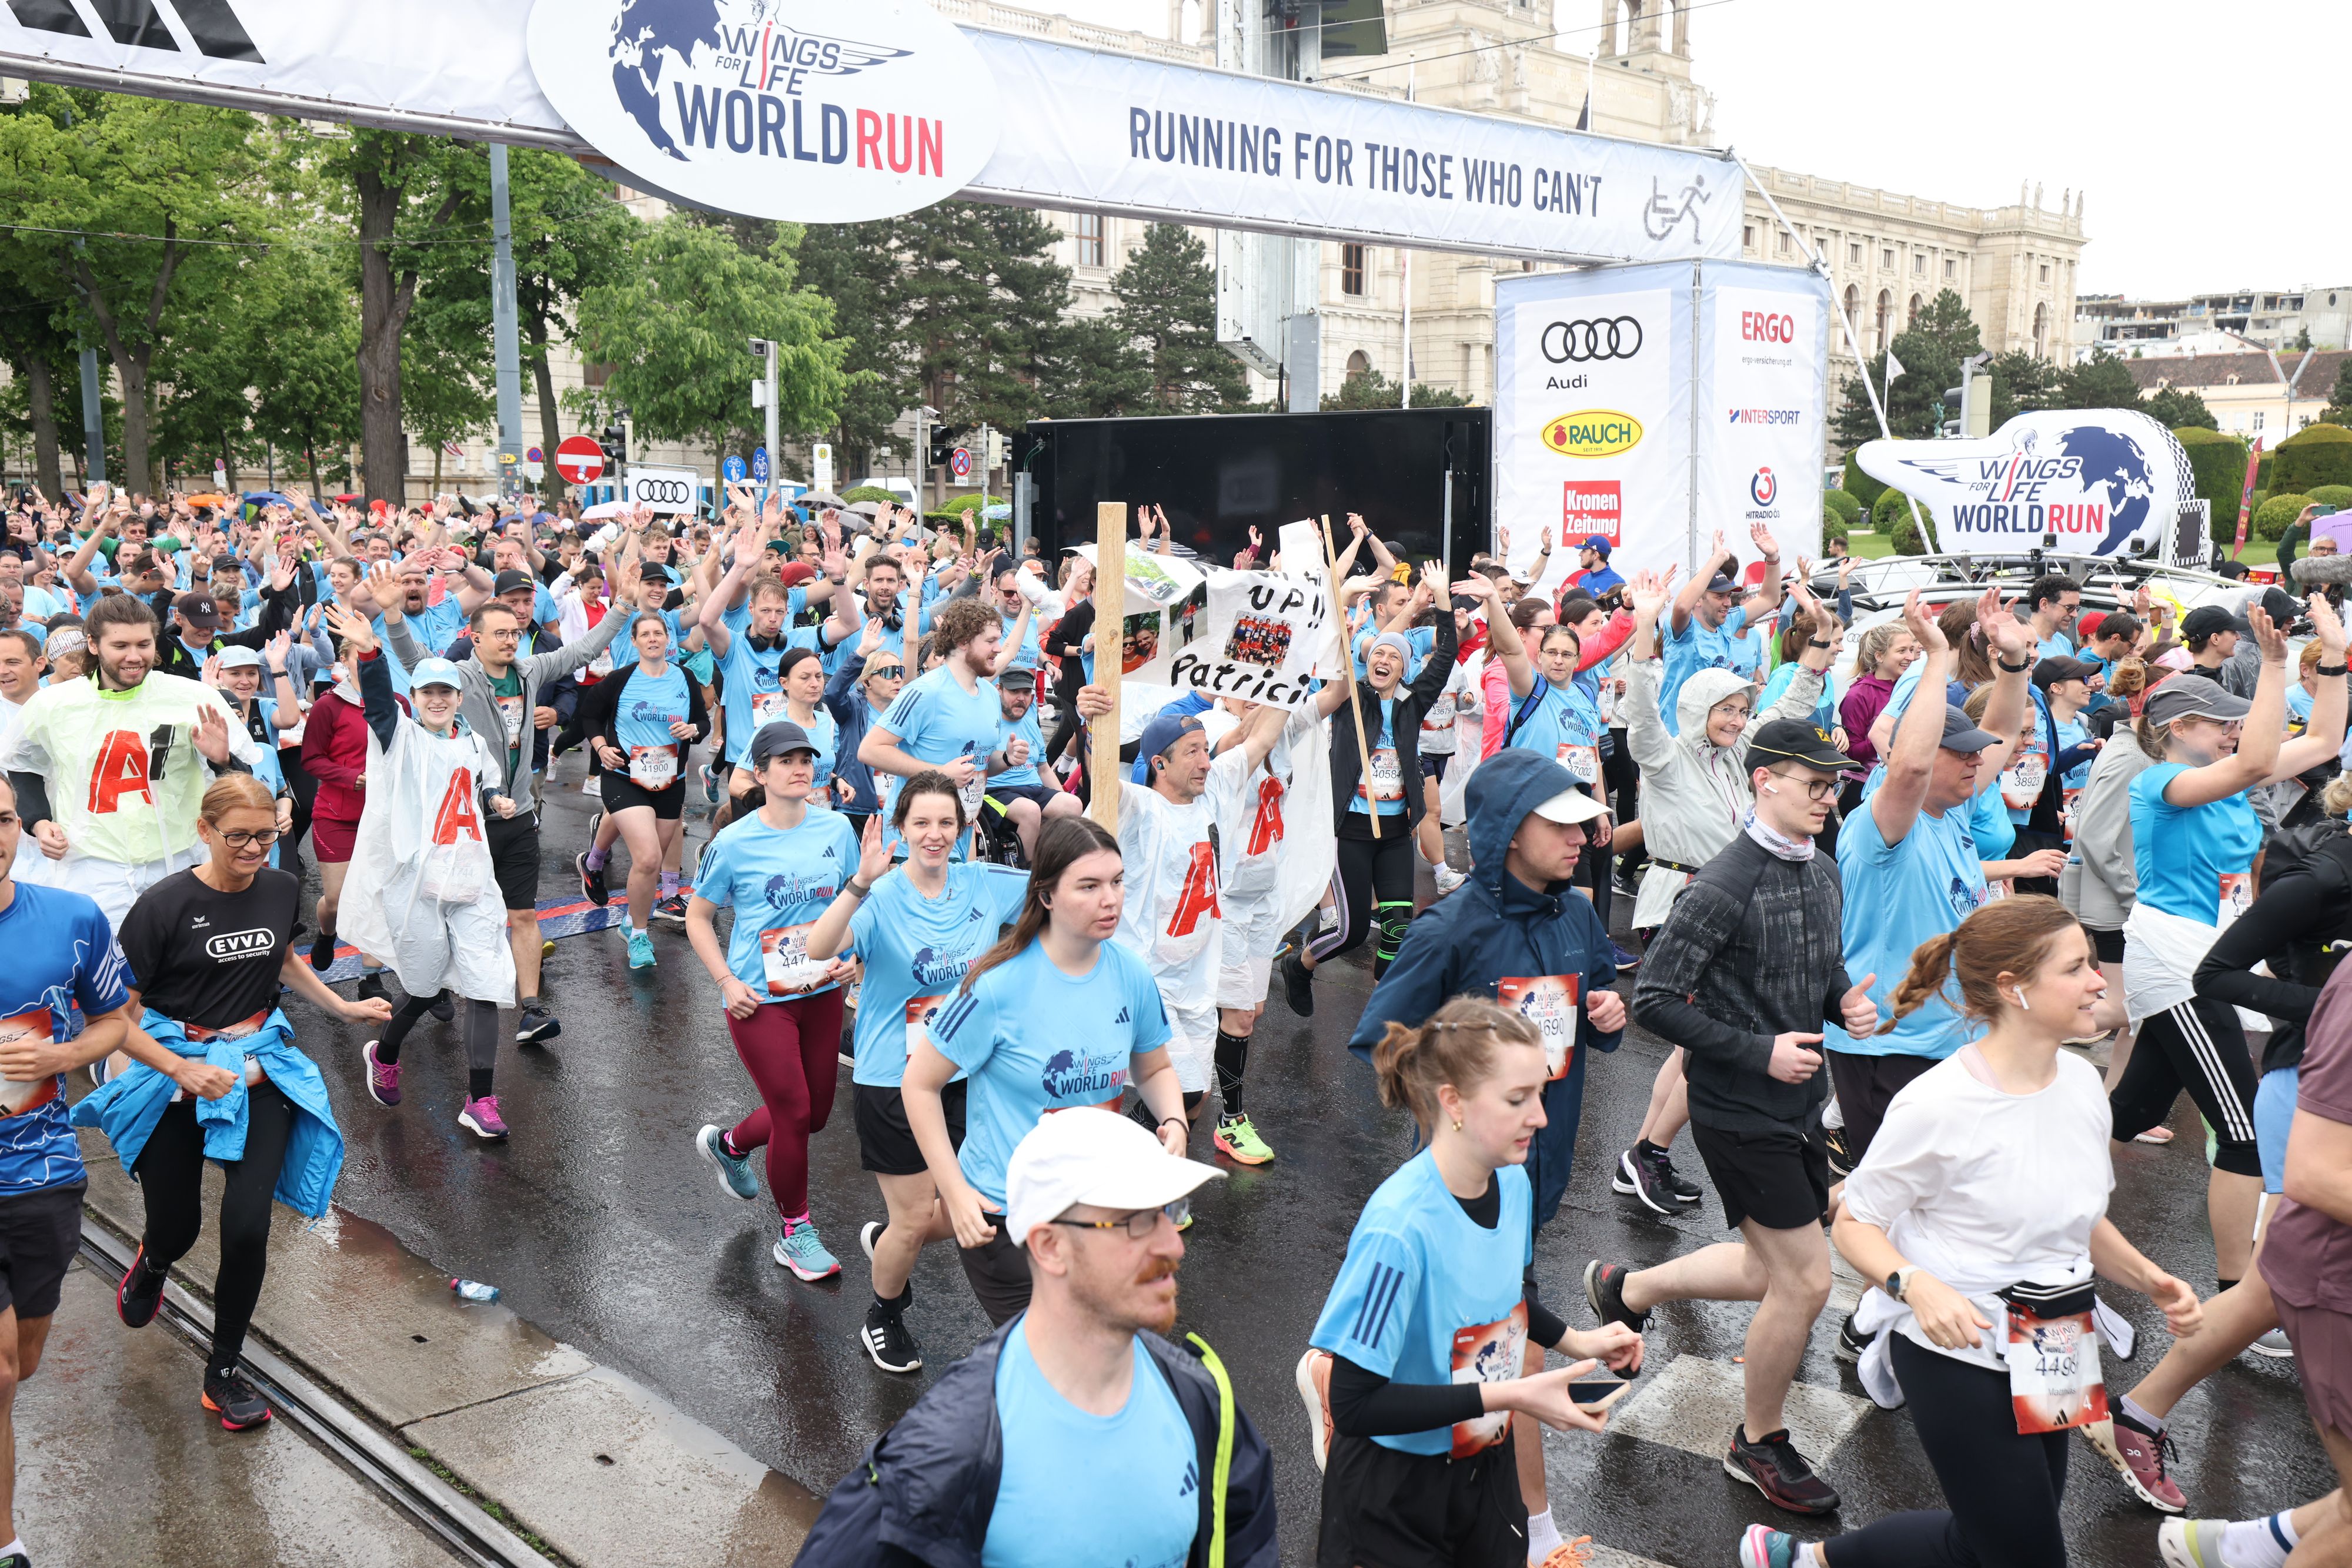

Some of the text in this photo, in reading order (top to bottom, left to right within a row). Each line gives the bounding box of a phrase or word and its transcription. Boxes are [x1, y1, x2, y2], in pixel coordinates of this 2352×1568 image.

[721, 21, 841, 70] WINGS
[716, 55, 741, 71] FOR
[739, 59, 808, 96] LIFE
[673, 81, 943, 178] WORLD RUN
[1129, 106, 1281, 177] RUNNING
[1295, 132, 1352, 187] FOR
[1364, 142, 1452, 200] THOSE
[1463, 158, 1522, 208] WHO
[1742, 311, 1794, 343] ERGO
[1742, 356, 1792, 367] ergo-versicherung.at
[1546, 375, 1588, 390] Audi
[1741, 409, 1800, 424] INTERSPORT
[1569, 423, 1631, 444] RAUCH
[1980, 452, 2080, 480] WINGS
[956, 477, 968, 486] Anfang
[1969, 482, 1990, 491] FOR
[1986, 482, 2047, 502] LIFE
[1566, 490, 1618, 511] Kronen
[1746, 508, 1780, 520] HITRADIO Ö3
[1953, 504, 2103, 533] WORLD RUN
[1566, 513, 1618, 537] Zeitung
[201, 601, 211, 613] NY
[1015, 655, 1032, 663] WORLD
[761, 678, 777, 686] WOR
[1171, 654, 1309, 704] Patrici
[640, 713, 667, 722] WORLD
[1432, 707, 1451, 716] 43679
[1568, 721, 1589, 737] WORLD
[1377, 737, 1395, 747] ORLD
[642, 763, 669, 773] 41900
[1372, 770, 1401, 779] 40584
[812, 772, 827, 783] ORLD
[2014, 776, 2040, 787] 38923
[786, 877, 813, 887] WINGS
[791, 884, 806, 892] LIFE
[777, 885, 834, 907] WORLD RUN
[215, 932, 269, 953] EVVA
[218, 955, 237, 963] access
[245, 950, 270, 958] security
[783, 952, 811, 968] 447
[934, 950, 961, 962] WINGS
[941, 958, 955, 967] LIFE
[927, 962, 968, 984] WORLD
[1541, 1001, 1554, 1009] LIFE
[1074, 1055, 1107, 1068] WINGS
[1079, 1066, 1098, 1076] LIFE
[1061, 1074, 1109, 1095] WORLD
[1488, 1363, 1506, 1373] WORLD
[2048, 1388, 2076, 1396] Matthias
[2083, 1394, 2093, 1410] 4
